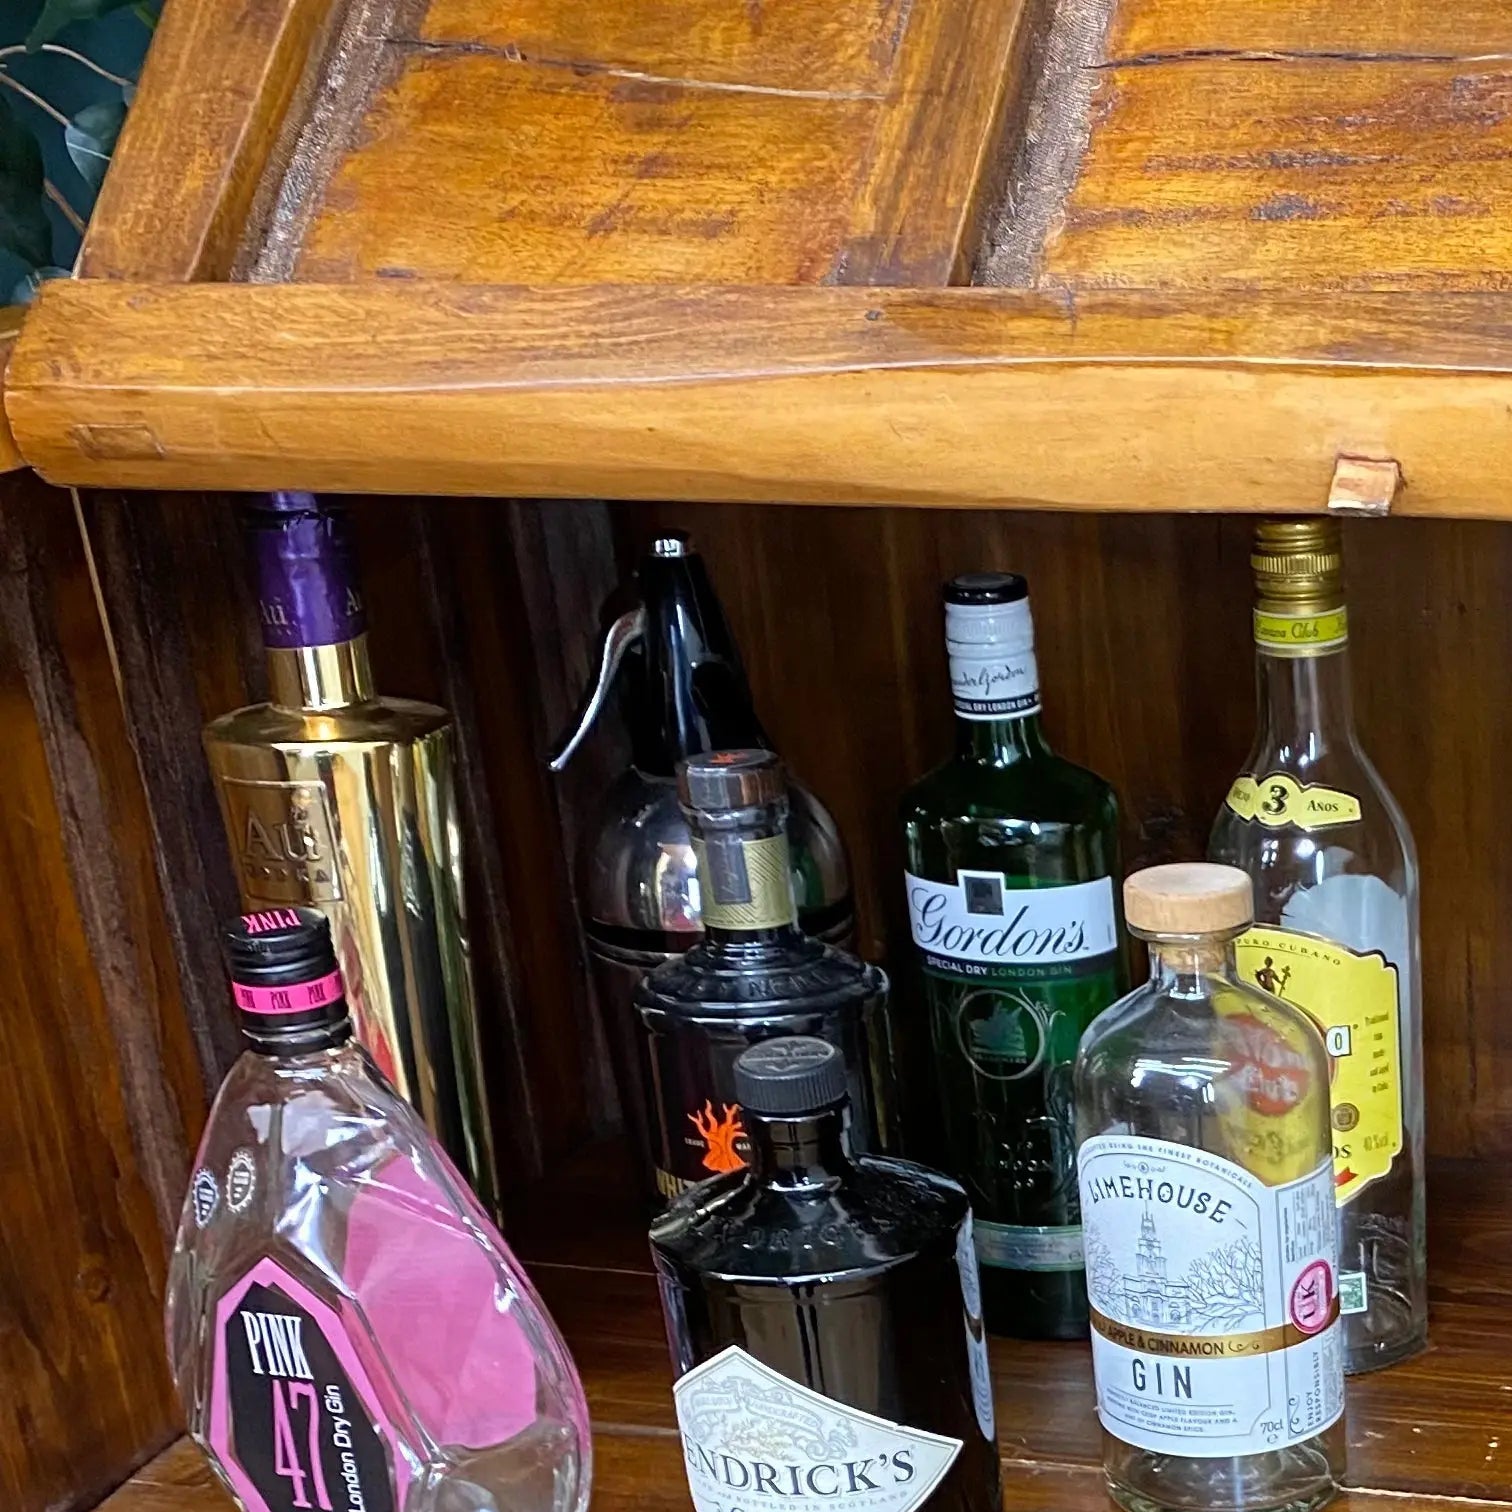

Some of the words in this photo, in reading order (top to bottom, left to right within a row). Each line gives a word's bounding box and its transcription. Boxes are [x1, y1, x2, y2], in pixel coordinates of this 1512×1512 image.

[1262, 784, 1290, 816] 3
[240, 908, 302, 934] PINK
[911, 886, 1086, 958] Gordon's
[926, 954, 964, 975] SPECIAL
[965, 964, 989, 976] DRY
[991, 966, 1046, 978] LONDON
[1049, 965, 1073, 976] GIN
[1278, 942, 1342, 967] CUBANO
[1195, 1157, 1254, 1189] BOTANICALS
[1087, 1175, 1233, 1225] LIMEHOUSE
[240, 1310, 314, 1380] PINK
[1108, 1326, 1135, 1346] APPLE
[1137, 1336, 1145, 1350] &
[1147, 1338, 1225, 1356] CINNAMON
[1131, 1358, 1193, 1399] GIN
[325, 1384, 341, 1414] Gin
[332, 1415, 353, 1449] Dry
[1259, 1418, 1284, 1434] 70cl
[272, 1378, 333, 1512] 47
[684, 1432, 916, 1498] ENDRICK'S
